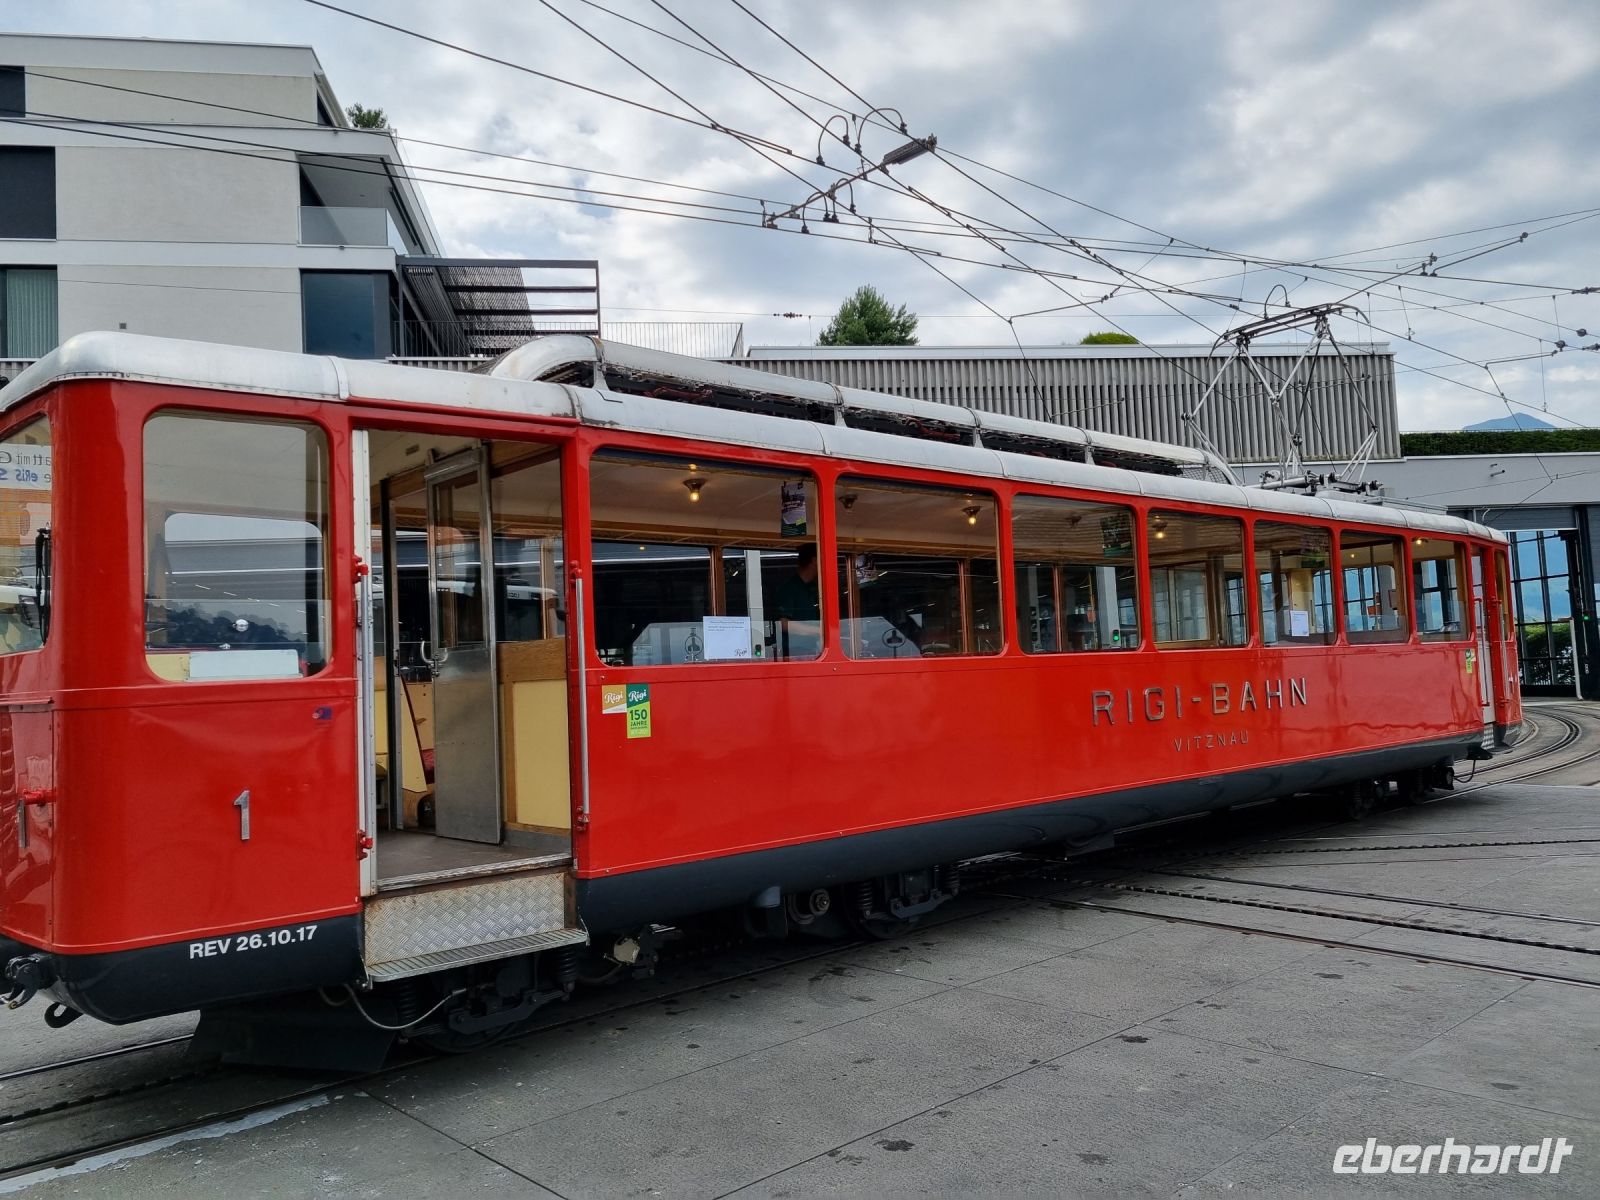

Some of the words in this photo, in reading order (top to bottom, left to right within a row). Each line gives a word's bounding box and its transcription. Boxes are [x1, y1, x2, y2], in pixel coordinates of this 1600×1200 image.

[604, 690, 623, 704] Rigi
[628, 689, 647, 702] Rigi
[1091, 676, 1308, 727] RIGI-BAHN
[629, 708, 648, 721] 150
[1173, 730, 1249, 752] VITZNAU
[233, 789, 250, 841] 1
[189, 938, 231, 960] REV
[236, 925, 318, 952] 26.10.17
